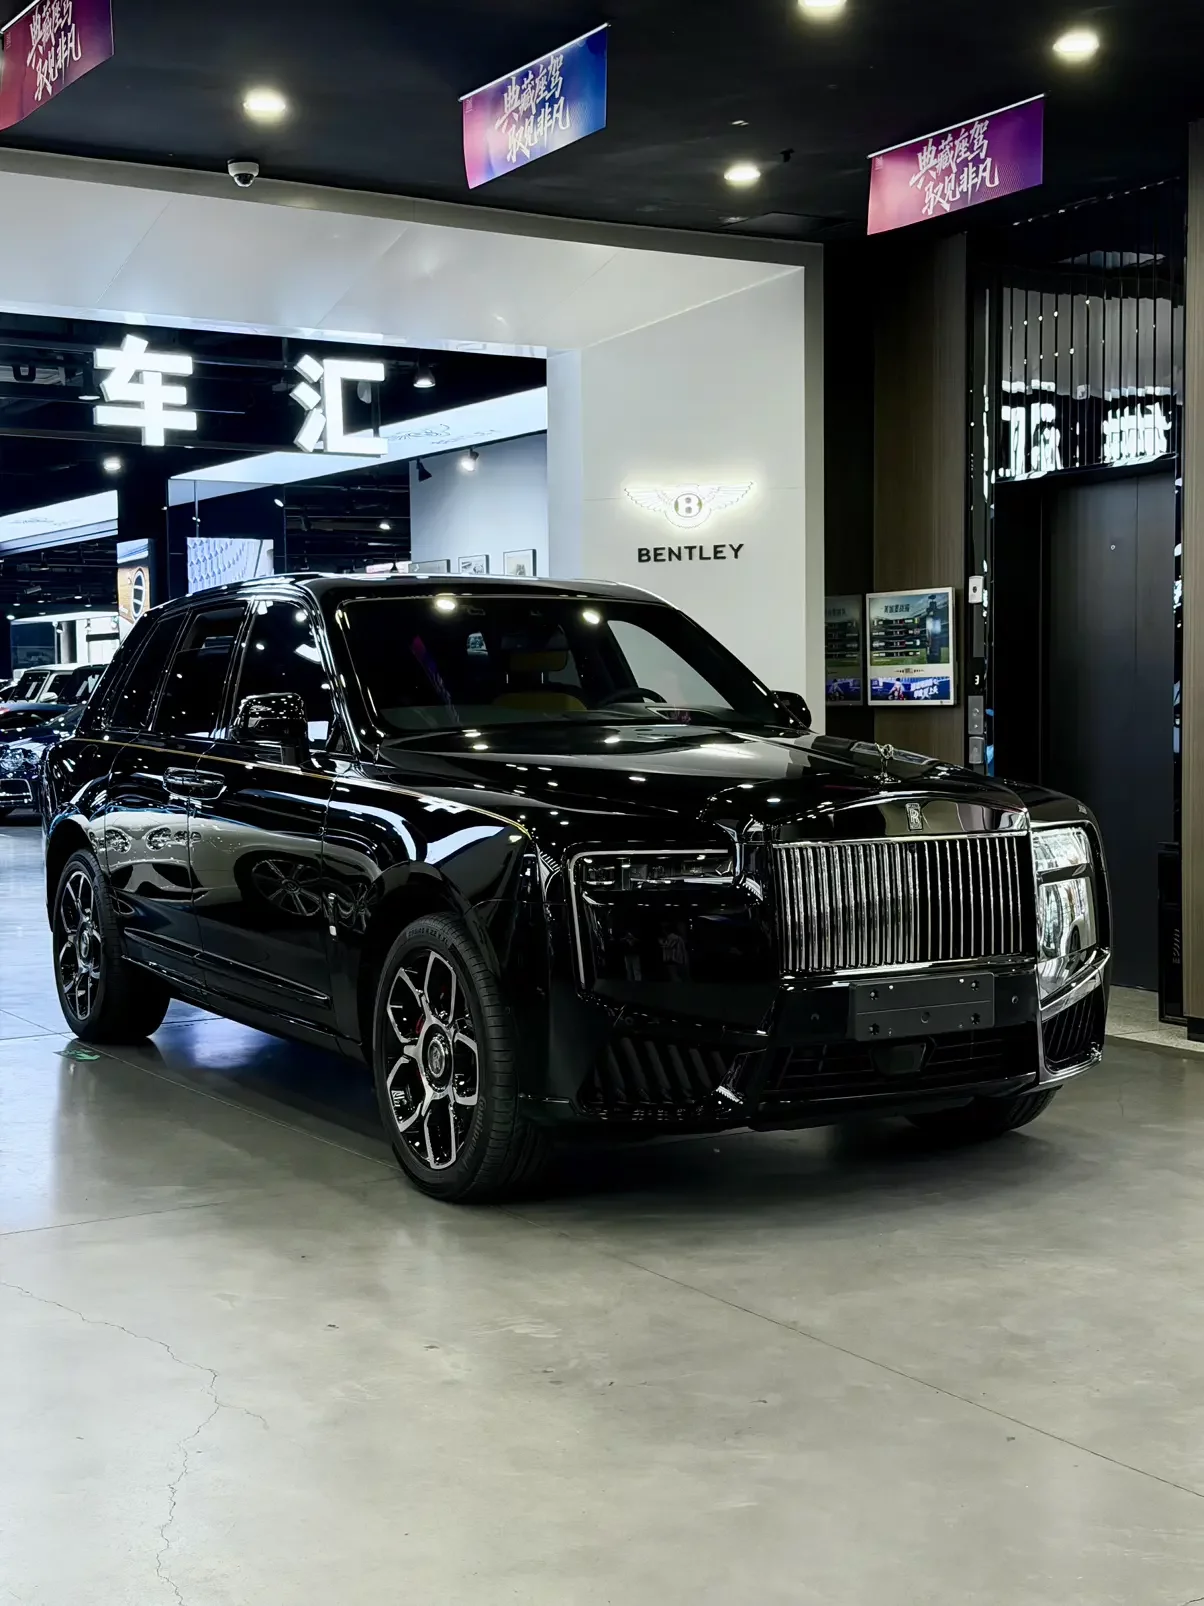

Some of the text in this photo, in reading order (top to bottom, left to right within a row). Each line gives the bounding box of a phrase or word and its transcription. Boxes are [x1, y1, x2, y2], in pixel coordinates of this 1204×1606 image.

[34, 23, 82, 101] 驭见非凡
[495, 54, 564, 133] 典藏座驾
[506, 96, 570, 163] 驭见非凡
[909, 120, 989, 189] 典藏座驾
[922, 157, 999, 216] 驭见非凡
[637, 543, 744, 563] BENTLEY
[974, 674, 980, 685] 3
